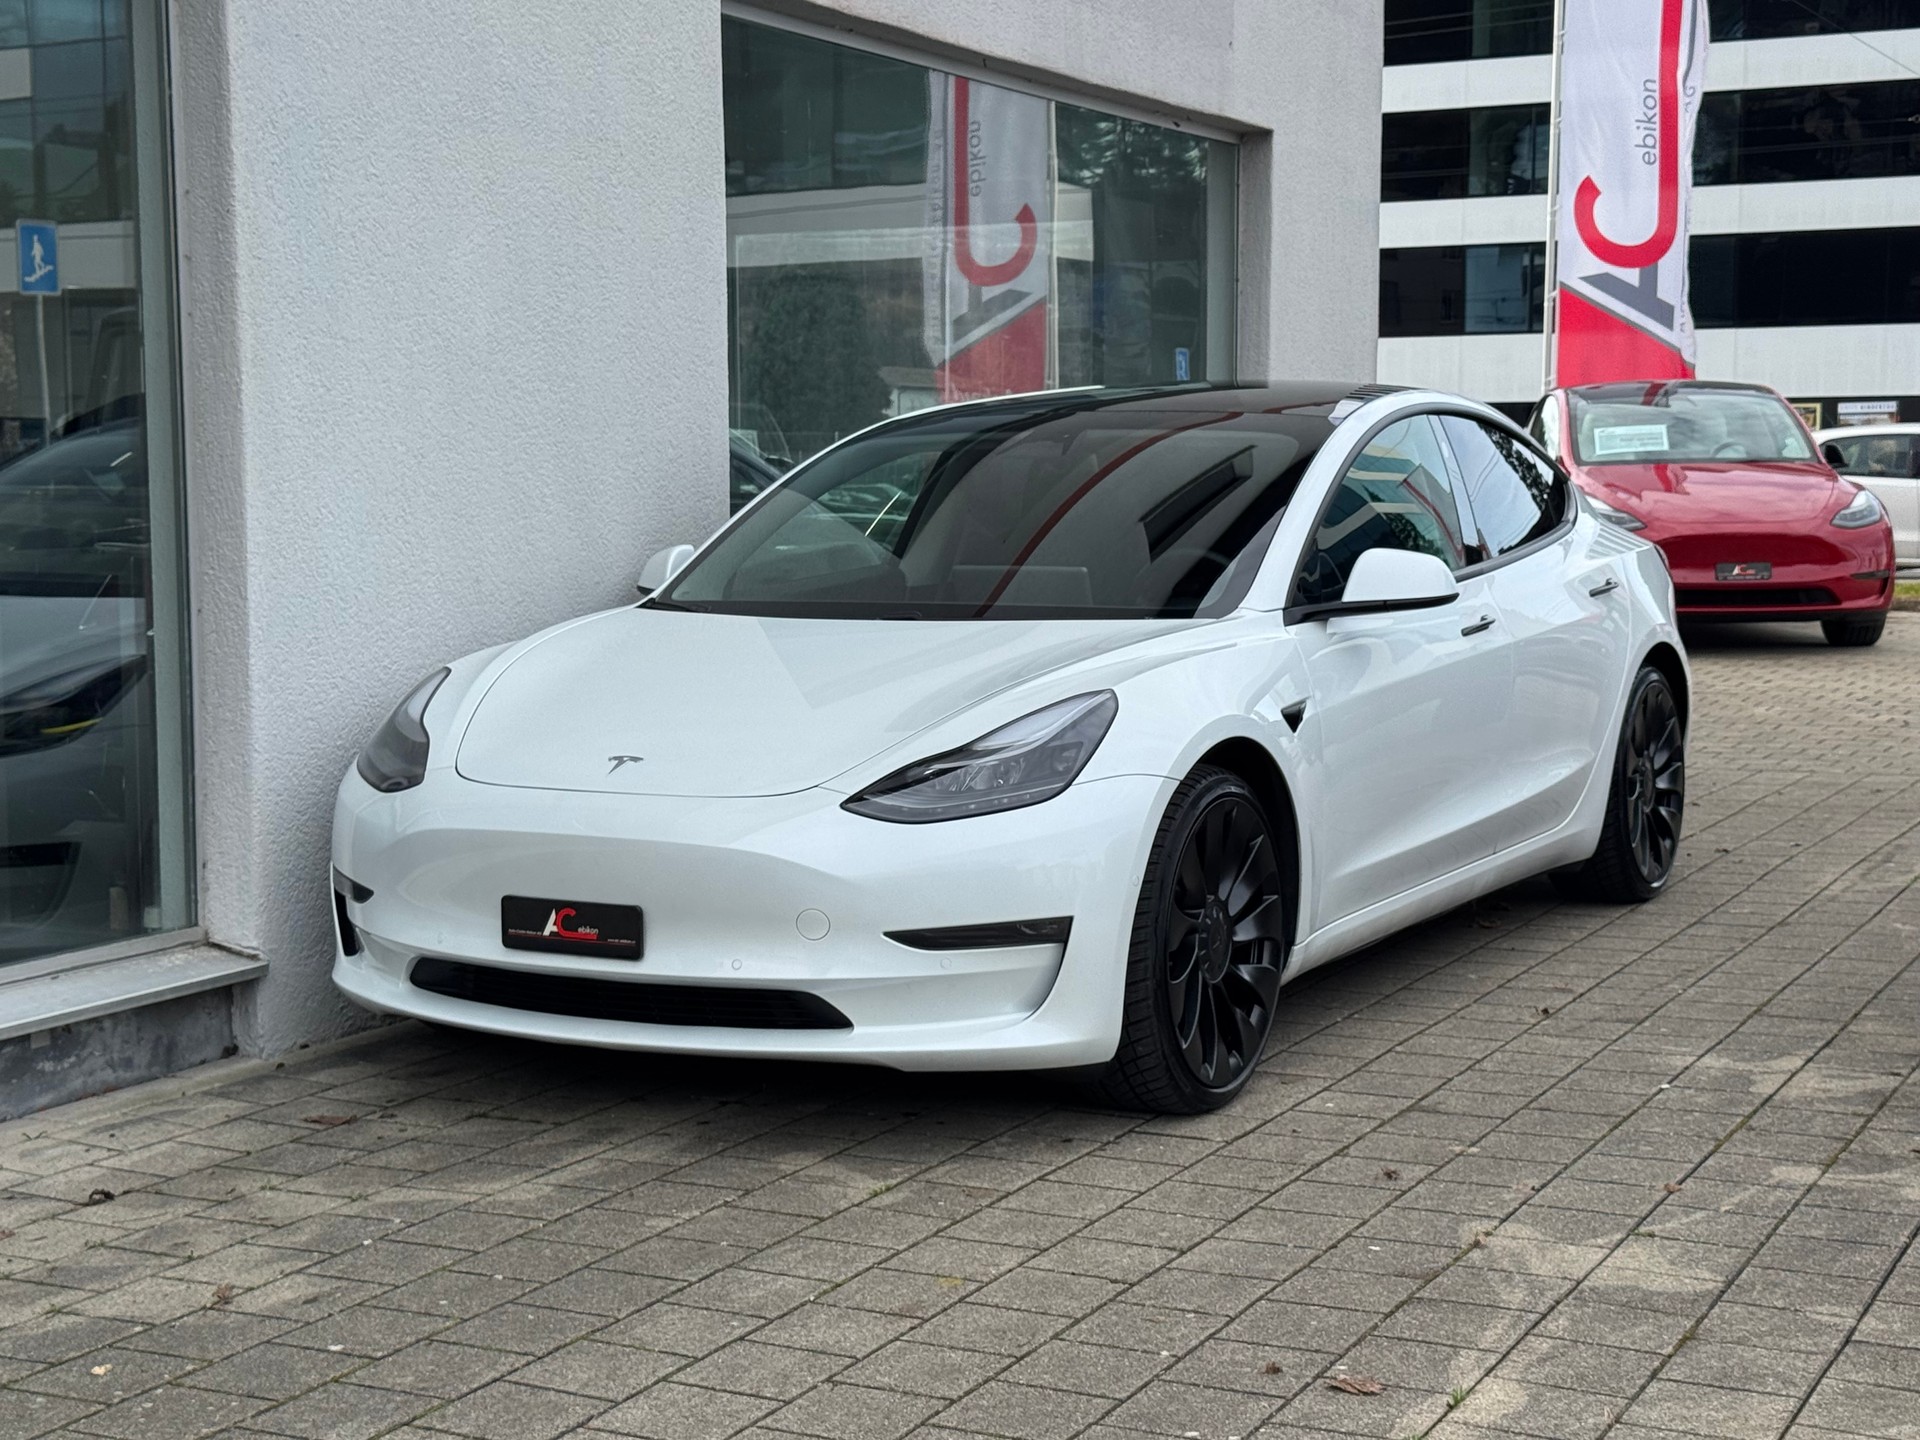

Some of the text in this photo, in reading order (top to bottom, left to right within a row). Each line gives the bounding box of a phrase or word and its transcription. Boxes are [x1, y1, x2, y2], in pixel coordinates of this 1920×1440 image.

[1635, 78, 1657, 166] ebikon
[542, 907, 599, 940] AC ebikon
